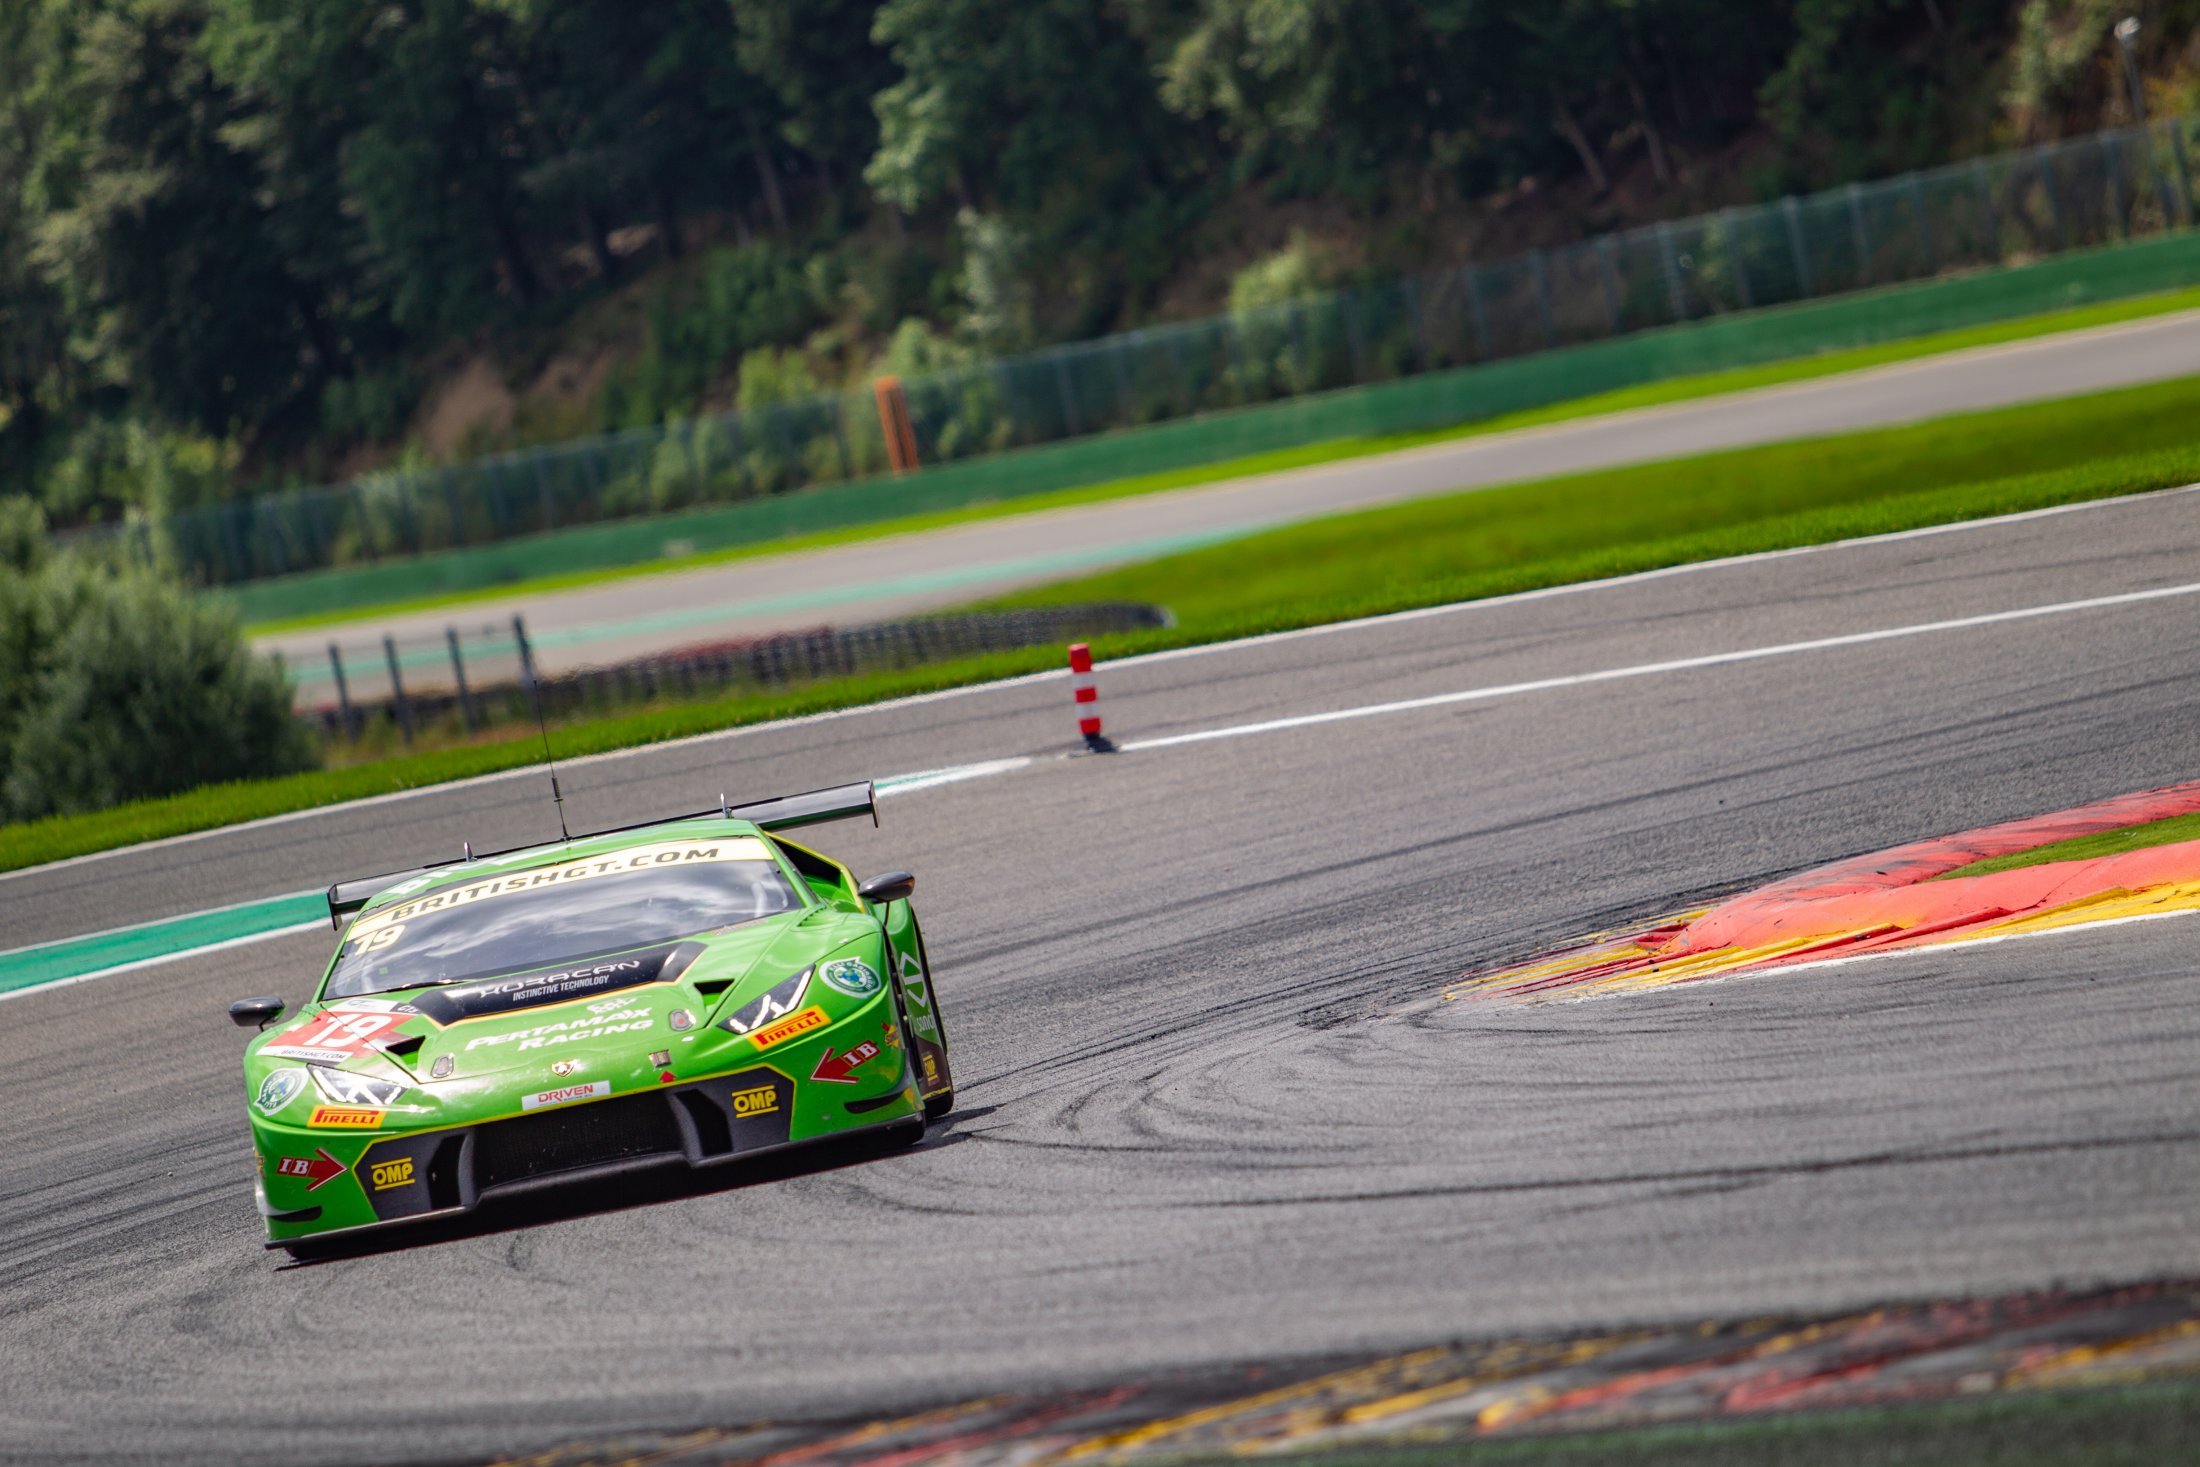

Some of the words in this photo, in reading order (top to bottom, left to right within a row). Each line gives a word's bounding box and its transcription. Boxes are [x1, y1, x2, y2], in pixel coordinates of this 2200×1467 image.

[391, 848, 719, 921] BRITISHGT.COM
[354, 924, 405, 956] 19
[513, 982, 559, 1002] INSTINCTIVE
[560, 975, 610, 992] TECHNOLOGY
[303, 1013, 394, 1048] 19
[465, 1007, 652, 1050] PERTAMAX
[517, 1019, 654, 1051] RACING
[755, 1011, 822, 1045] PIRELLI
[538, 1084, 594, 1102] DRIVEN
[733, 1088, 777, 1112] OMP
[314, 1109, 380, 1124] PIRELLI
[372, 1162, 414, 1185] OMP
